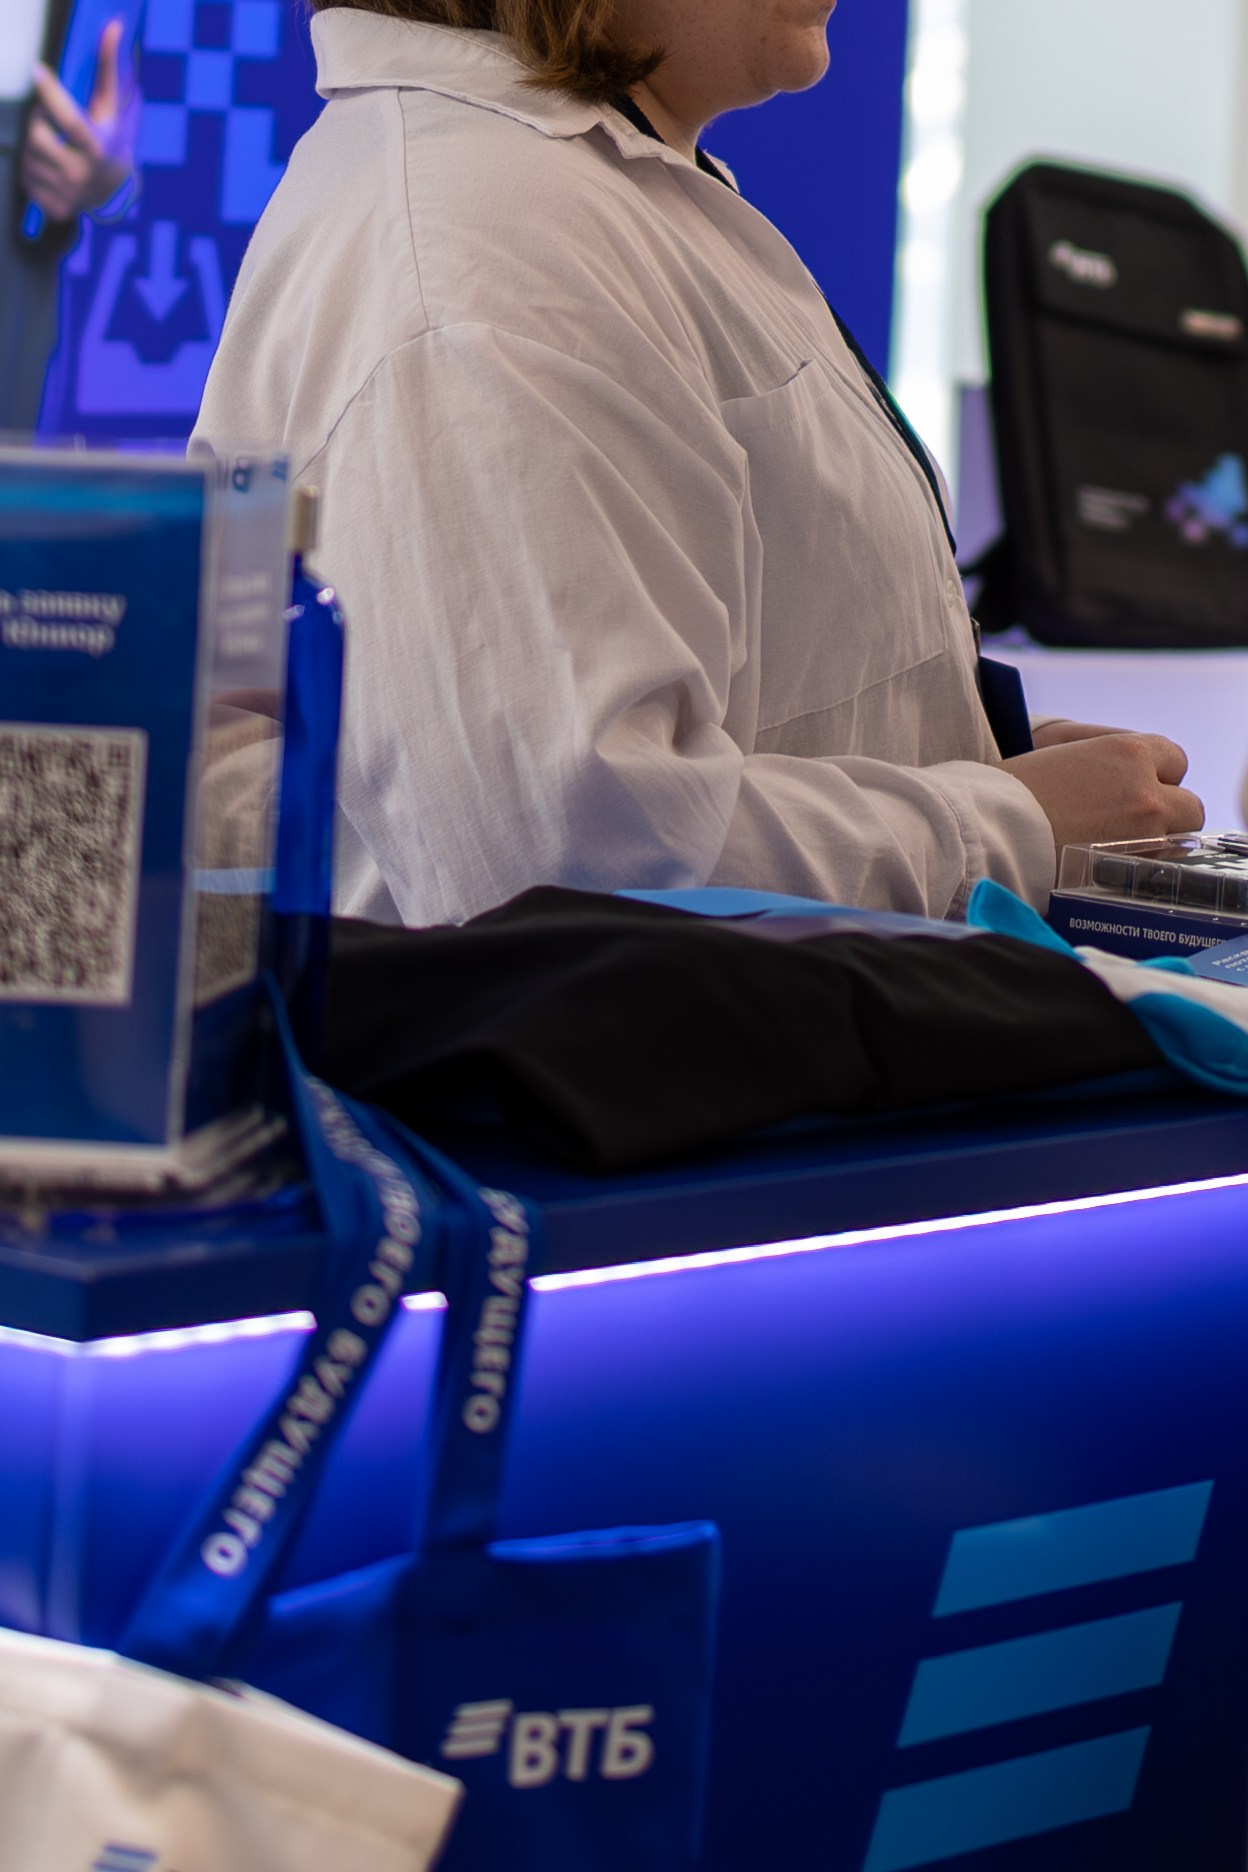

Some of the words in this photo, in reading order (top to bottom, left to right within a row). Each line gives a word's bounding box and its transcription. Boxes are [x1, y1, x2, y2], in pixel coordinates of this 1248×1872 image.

[1069, 917, 1140, 938] ВОЗМОЖНОСТИ
[1143, 928, 1176, 943] ТВОЕГО
[202, 1328, 368, 1578] БУДУЩЕГО
[508, 1704, 655, 1789] ВТБ
